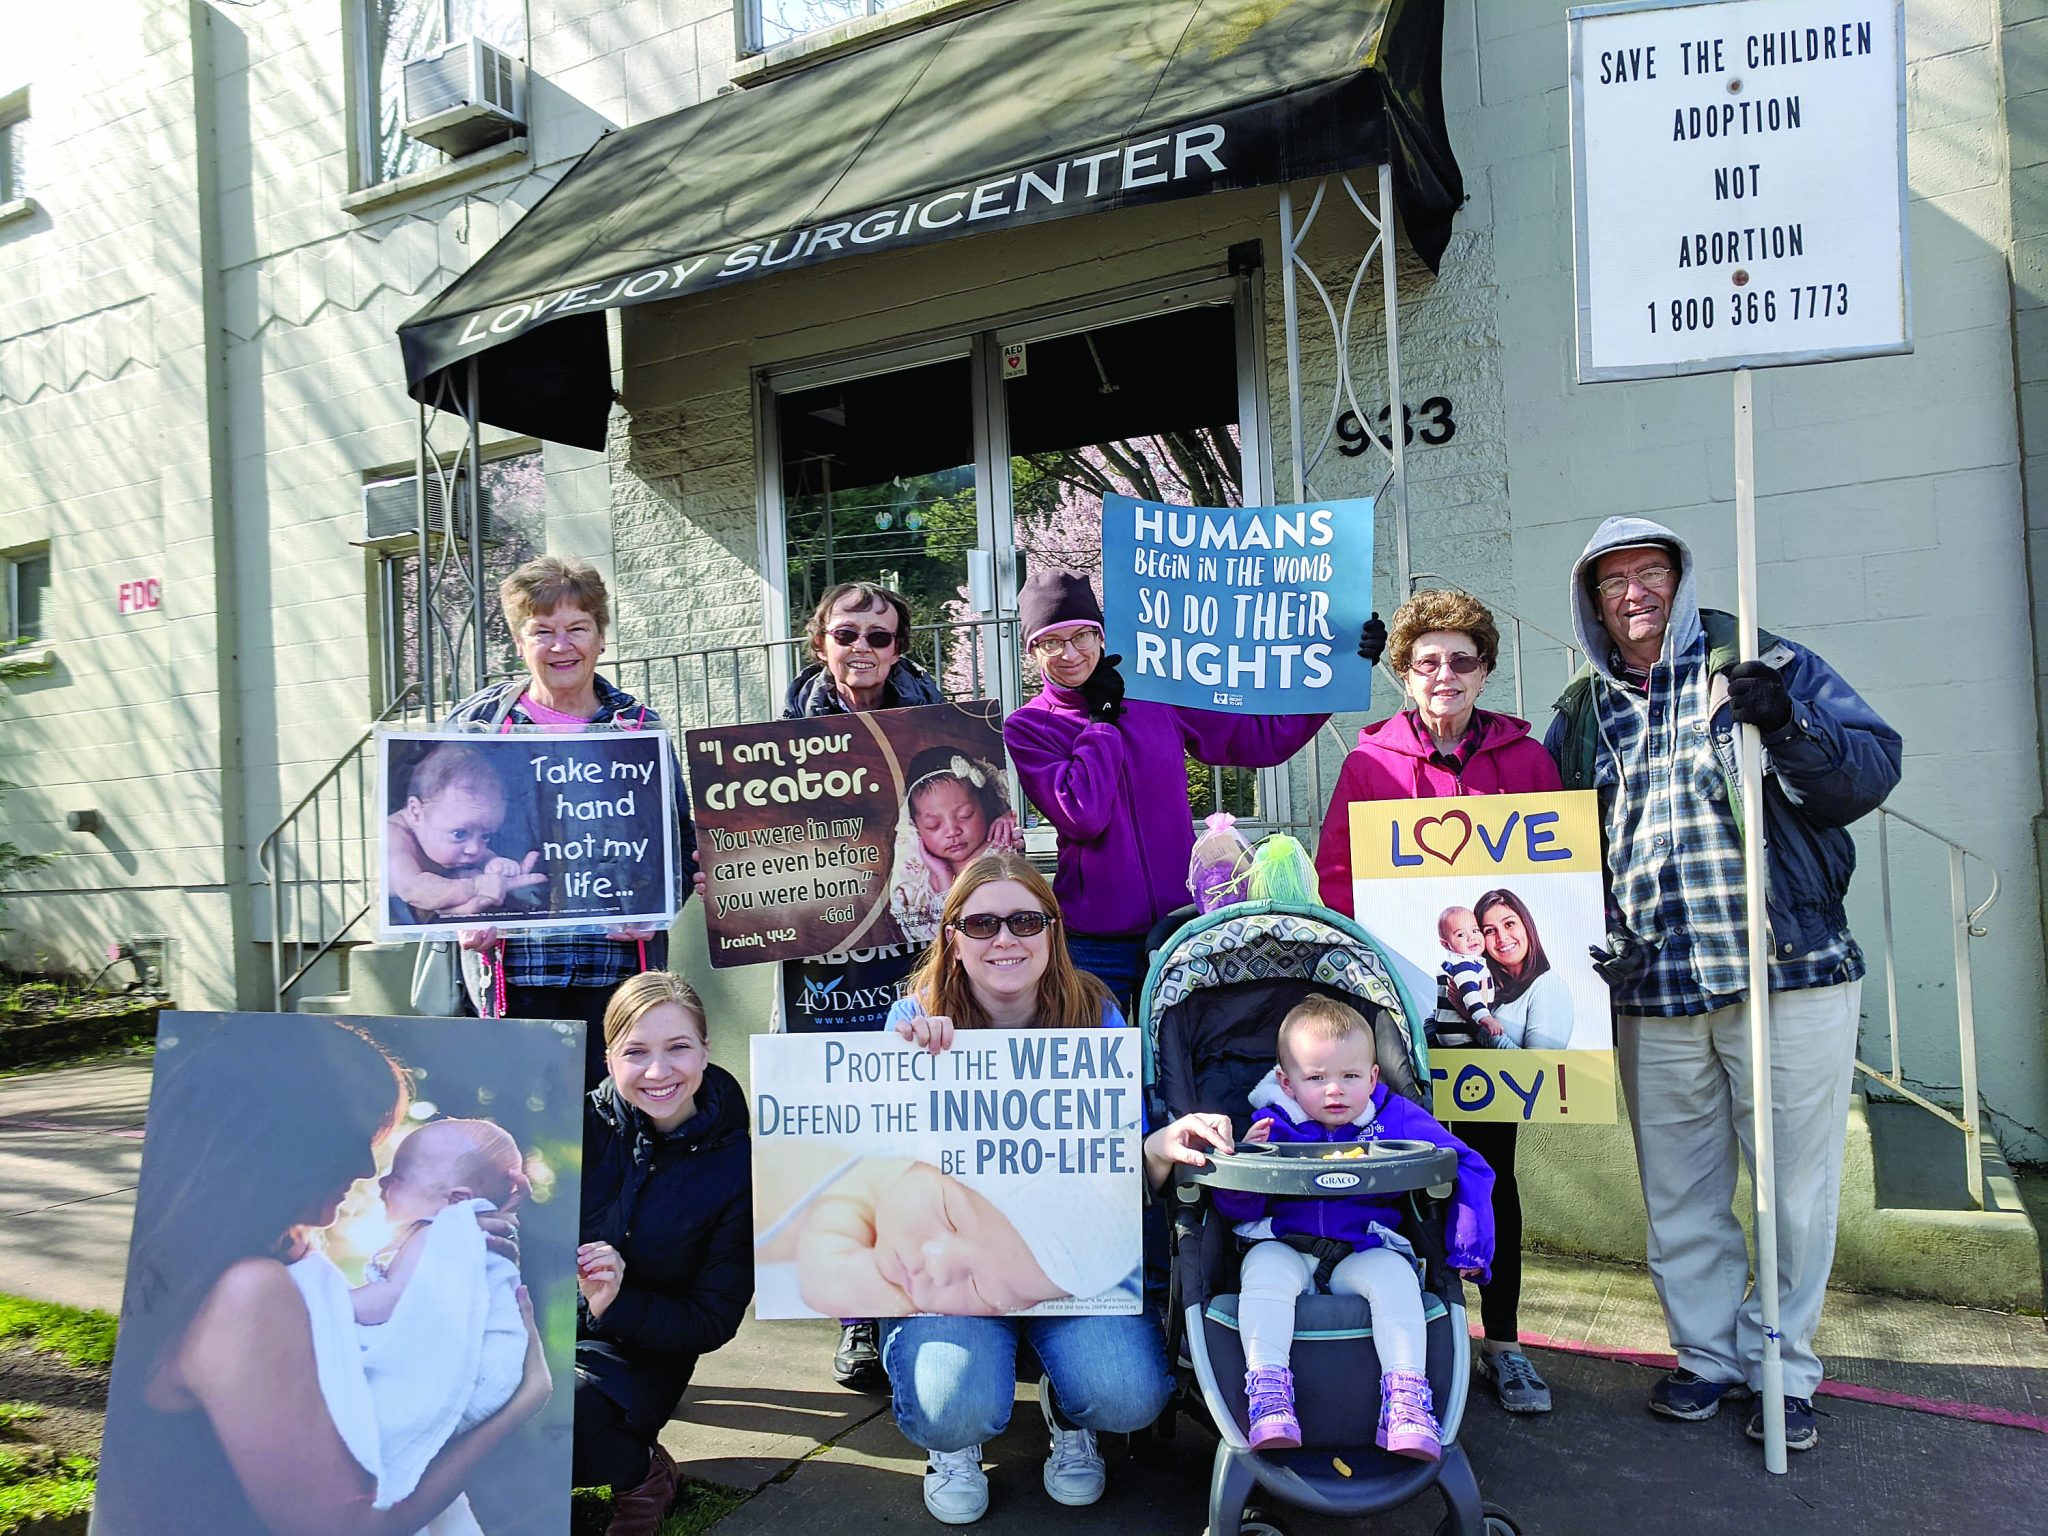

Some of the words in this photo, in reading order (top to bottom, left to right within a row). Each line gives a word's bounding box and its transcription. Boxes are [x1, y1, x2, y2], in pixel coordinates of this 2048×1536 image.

[1600, 46, 1657, 85] SAVE
[1680, 39, 1725, 75] THE
[1747, 21, 1871, 69] CHILDREN
[1673, 96, 1801, 141] ADOPTION
[1714, 164, 1761, 201] NOT
[457, 256, 709, 346] LOVEJOY
[717, 123, 1228, 278] SURGICENTER
[1678, 223, 1803, 268] ABORTION
[1647, 302, 1657, 333] 1
[1671, 297, 1714, 332] 800
[1731, 290, 1776, 326] 366
[1790, 283, 1849, 320] 7773
[1005, 345, 1023, 356] AED
[1336, 396, 1456, 457] 933
[1134, 507, 1334, 551] HUMANS
[1225, 557, 1265, 587] THE
[1273, 552, 1333, 585] WOMB
[119, 578, 160, 614] FDC
[1137, 587, 1170, 629] SO
[1183, 593, 1218, 637] DO
[1136, 631, 1333, 690] RIGHTS
[732, 741, 786, 767] am
[788, 733, 852, 765] your
[529, 755, 604, 784] Take
[610, 760, 655, 785] my
[556, 790, 635, 821] hand
[705, 767, 880, 811] creator.
[543, 833, 596, 861] not
[603, 838, 649, 863] my
[709, 828, 749, 852] You
[752, 824, 804, 847] were
[807, 818, 828, 841] in
[832, 817, 864, 841] my
[713, 860, 756, 883] care
[761, 852, 809, 876] even
[814, 844, 879, 870] before
[565, 871, 633, 898] life...
[716, 890, 754, 919] you
[758, 884, 809, 907] were
[819, 904, 854, 924] -God
[720, 932, 766, 950] Isaiah
[766, 927, 797, 943] 44:2
[831, 985, 892, 1011] DAYS
[825, 1040, 939, 1084] PROTECT
[950, 1050, 997, 1079] THE
[1008, 1036, 1135, 1080] WEAK.
[757, 1094, 861, 1136] DEFEND
[871, 1103, 917, 1133] THE
[929, 1088, 1136, 1132] INNOCENT.
[941, 1150, 966, 1175] BE
[976, 1137, 1135, 1174] PRO-LIFE.
[1321, 1176, 1356, 1185] GRACO
